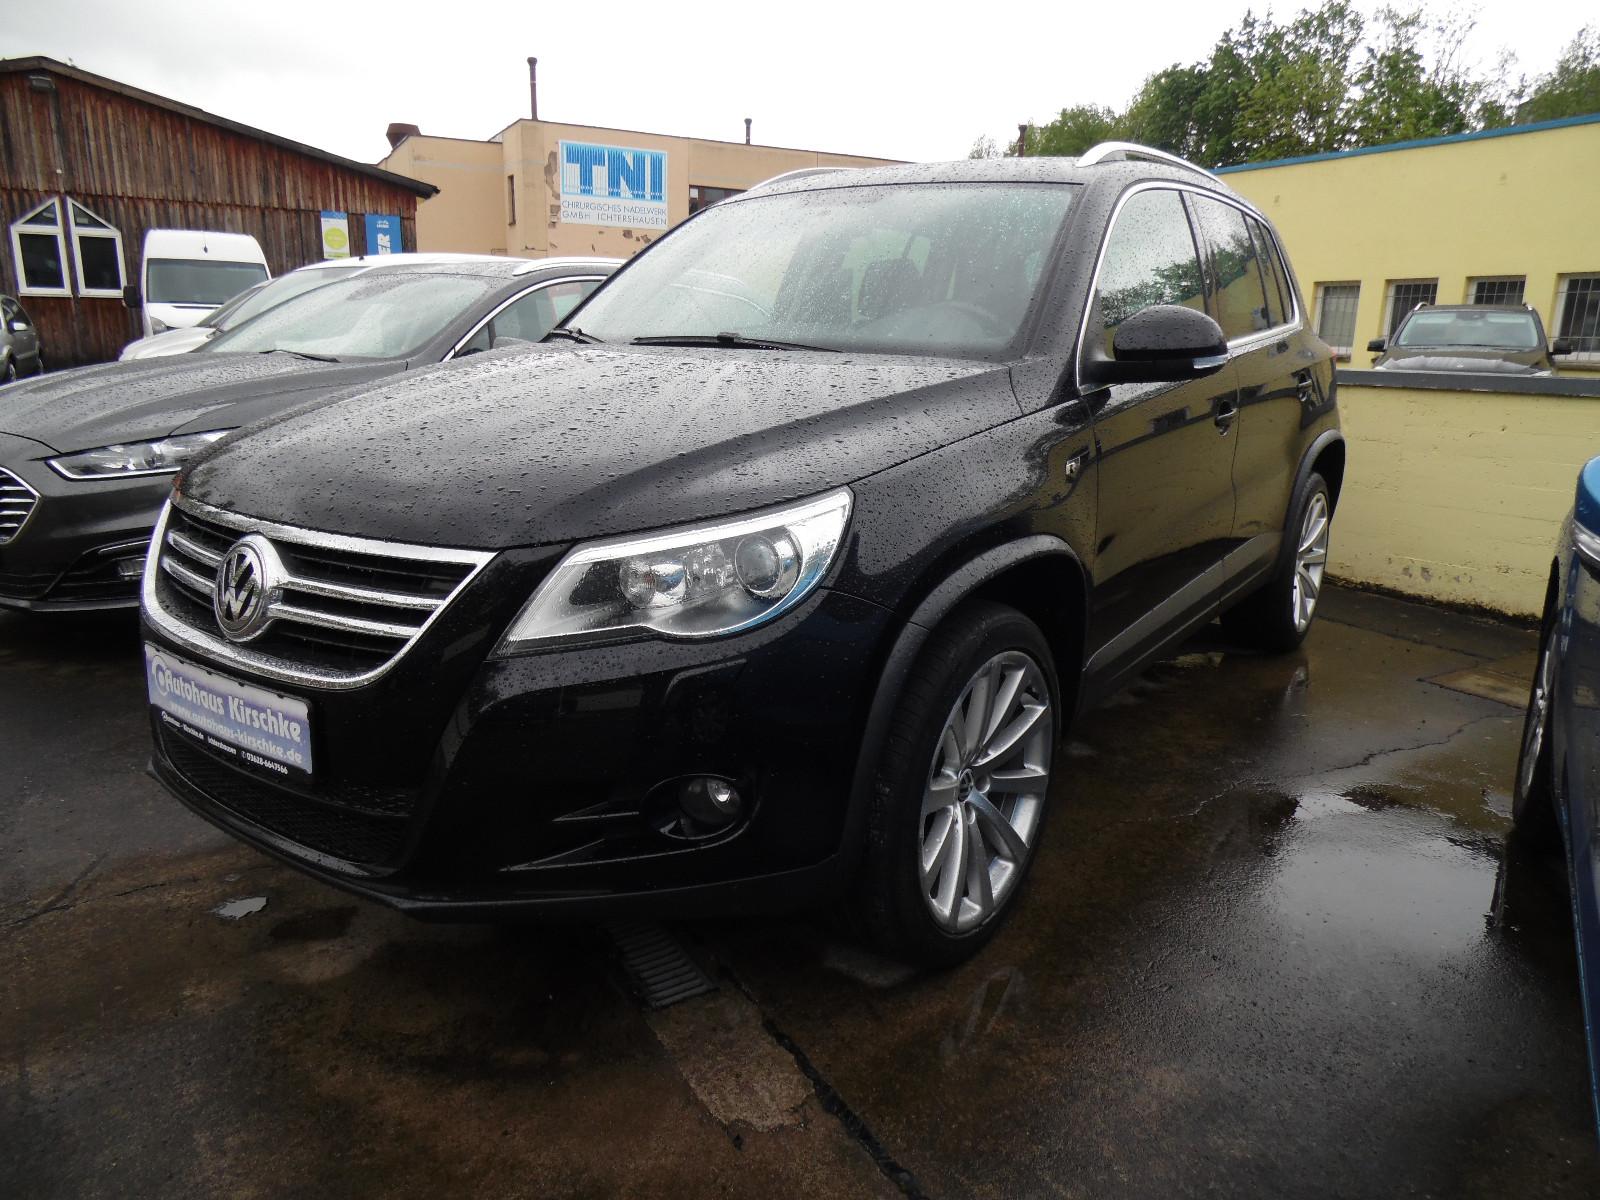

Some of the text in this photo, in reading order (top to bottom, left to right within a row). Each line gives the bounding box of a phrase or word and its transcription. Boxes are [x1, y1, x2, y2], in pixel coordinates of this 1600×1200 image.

[565, 144, 663, 200] TNI
[561, 200, 666, 215] CHIRURGISCHES NADELWERK
[562, 210, 667, 225] GMBH ICHTERSHAUSEN
[165, 670, 224, 715] Autohaus
[228, 695, 301, 743] Kirschke
